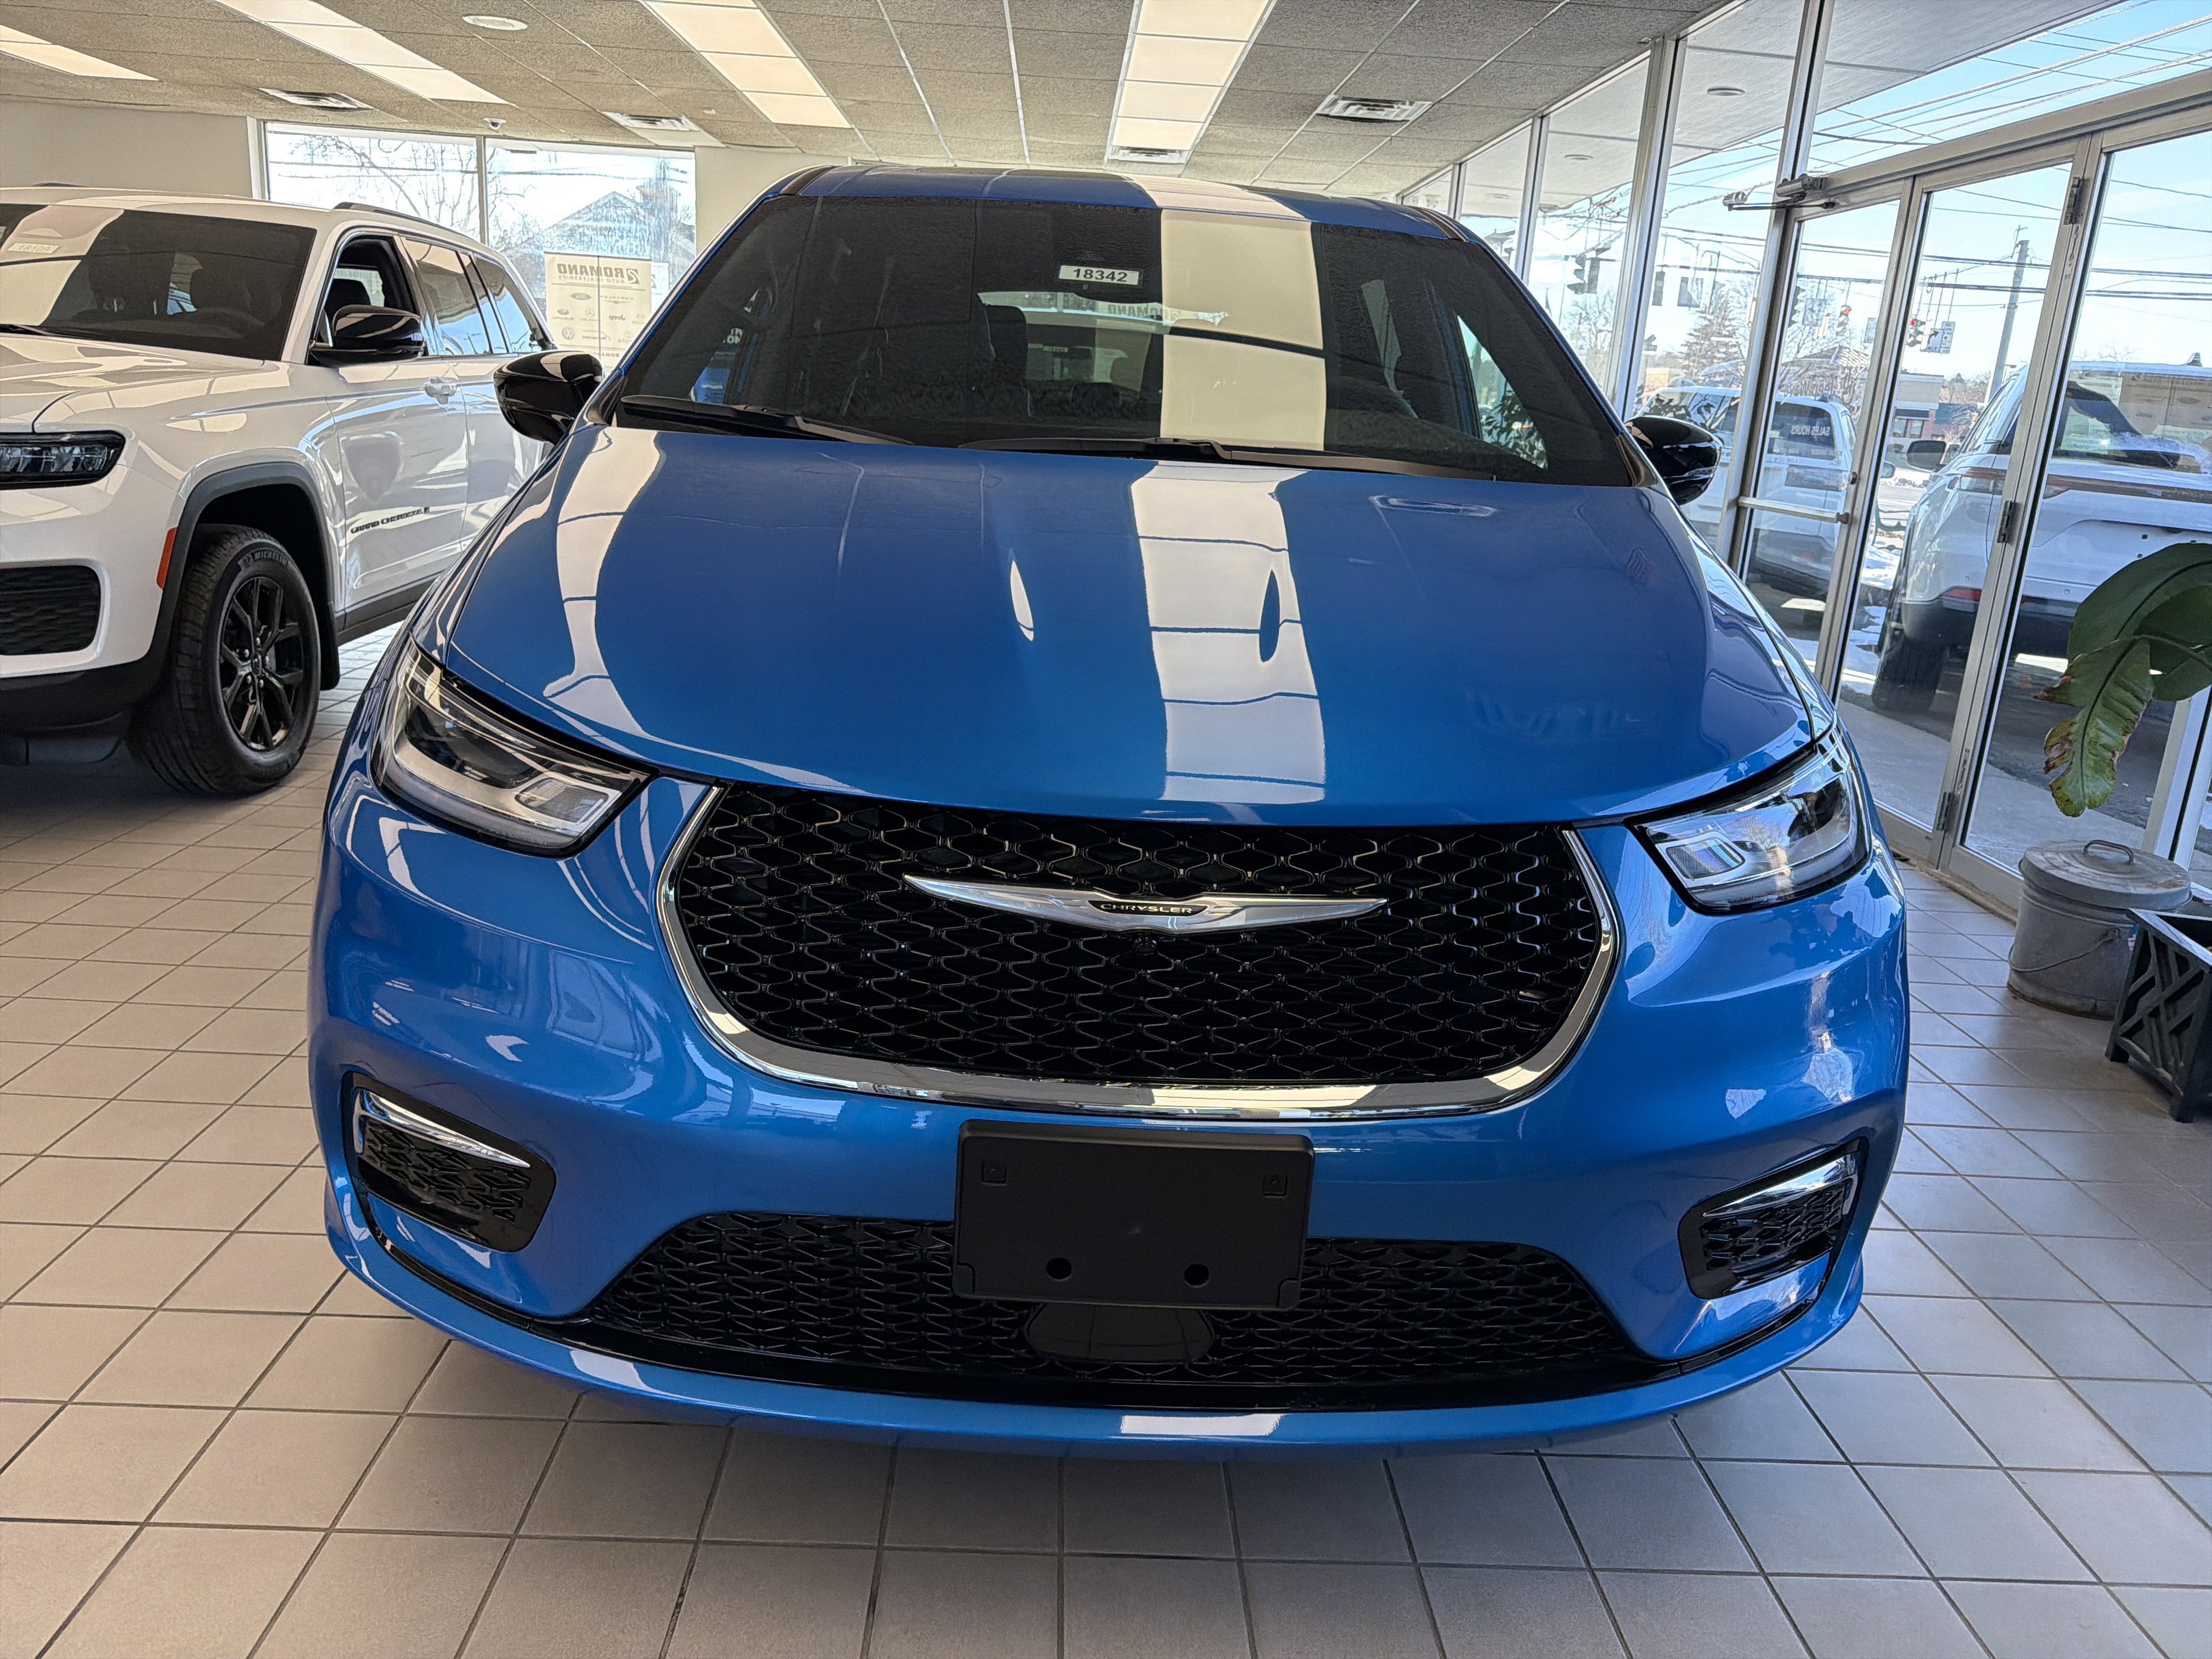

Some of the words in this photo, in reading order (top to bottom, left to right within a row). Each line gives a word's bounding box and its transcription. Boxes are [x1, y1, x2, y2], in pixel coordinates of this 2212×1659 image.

[1073, 268, 1128, 282] 18342
[254, 550, 289, 567] MICHELIN
[1100, 904, 1192, 913] CHRYSLER
